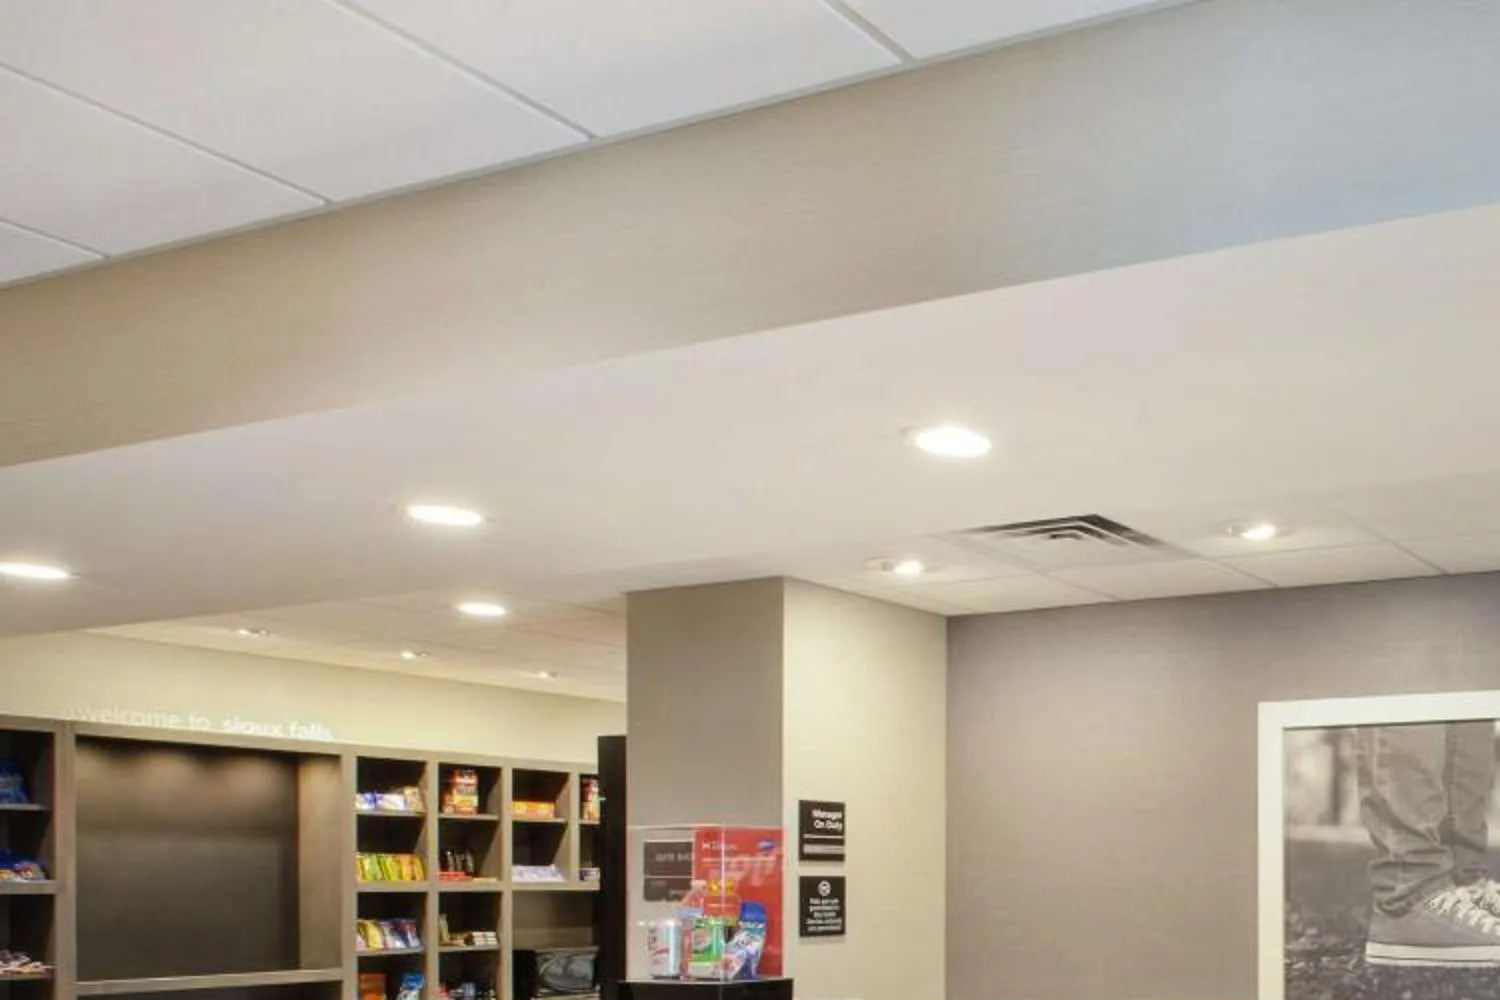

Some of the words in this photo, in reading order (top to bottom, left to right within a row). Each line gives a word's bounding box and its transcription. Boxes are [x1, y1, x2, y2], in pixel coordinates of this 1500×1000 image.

[76, 705, 180, 727] welcome
[188, 712, 210, 731] to
[222, 711, 283, 738] sioux
[289, 719, 333, 741] falls
[813, 819, 825, 829] On
